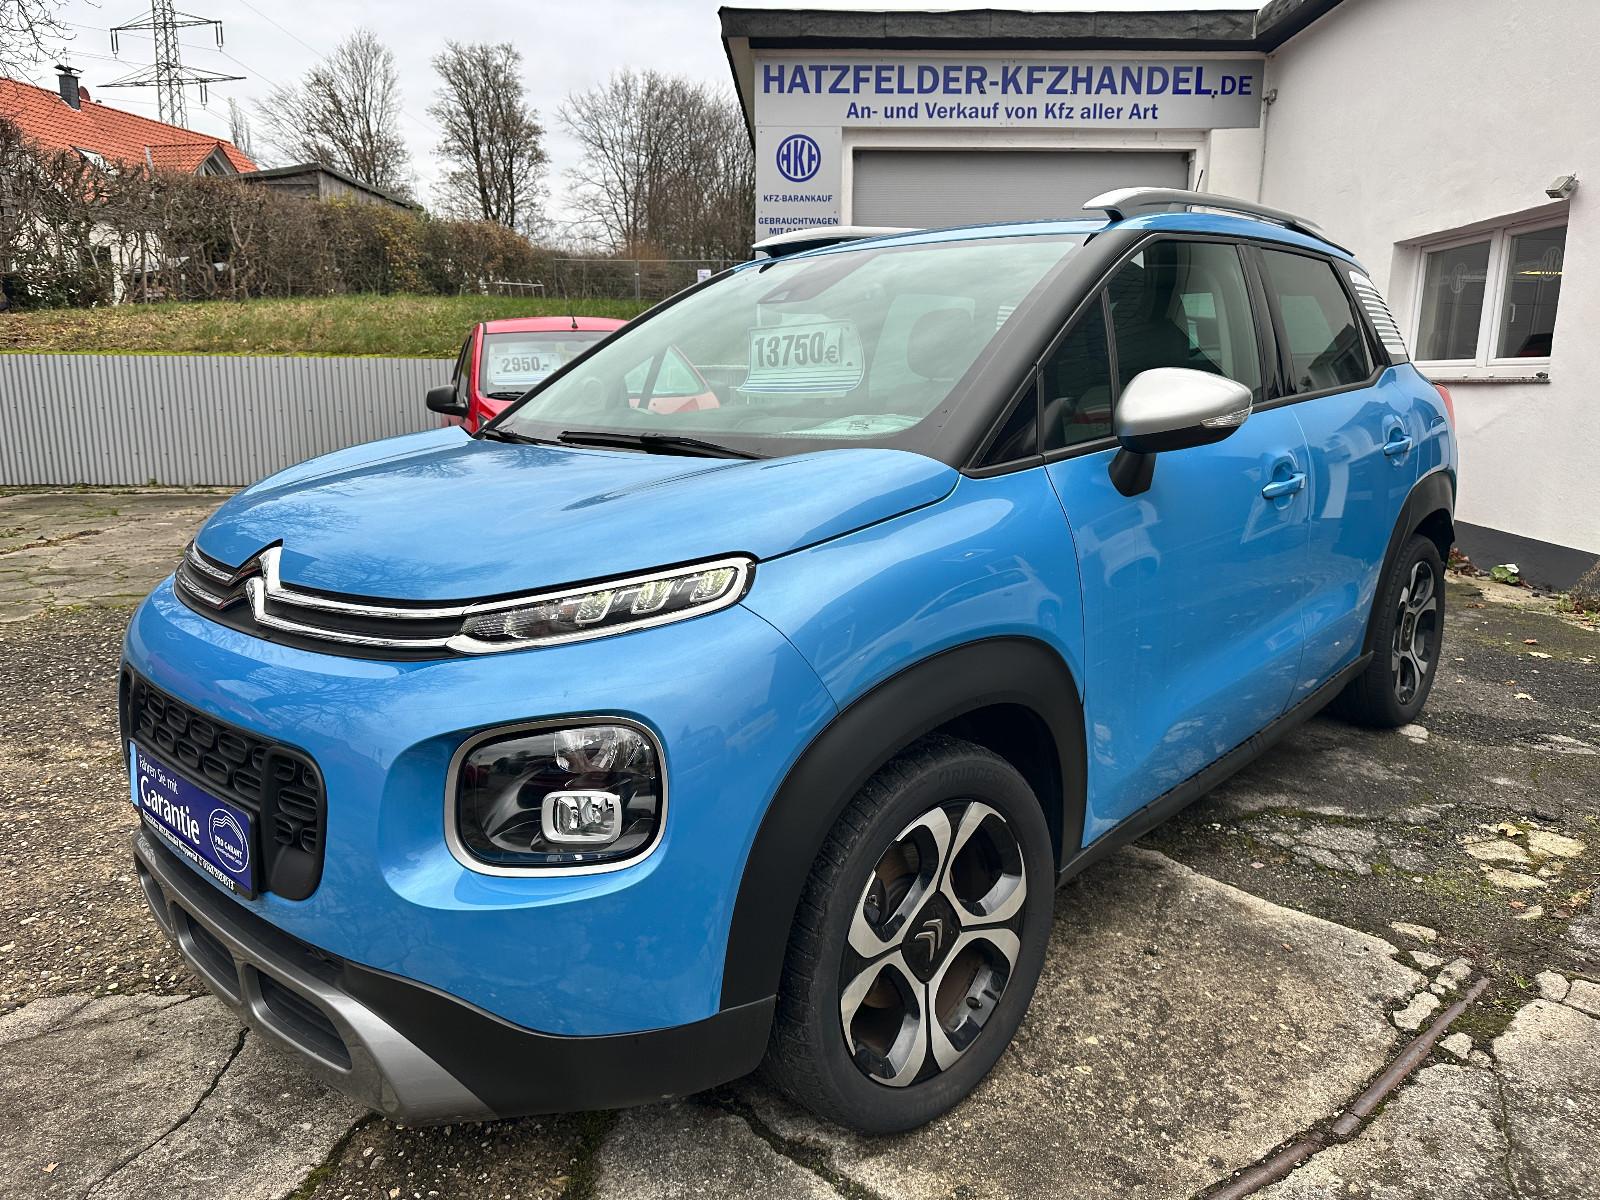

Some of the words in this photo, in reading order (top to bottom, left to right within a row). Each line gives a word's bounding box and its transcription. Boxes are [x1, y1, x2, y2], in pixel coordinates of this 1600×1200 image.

[763, 64, 1253, 97] HATZFELDER-KFZHANDEL.DE
[846, 102, 878, 119] An-
[884, 102, 919, 119] und
[925, 102, 1000, 119] Verkauf
[1005, 107, 1037, 119] von
[1045, 102, 1074, 119] Kfz
[1080, 103, 1123, 119] aller
[1129, 103, 1158, 119] Art
[763, 194, 833, 203] KFZ-BARANKAUF
[758, 217, 839, 225] GEBRAUCHTWAGEN
[769, 227, 784, 235] MIT
[157, 768, 167, 787] Sie
[140, 775, 200, 845] Garantie
